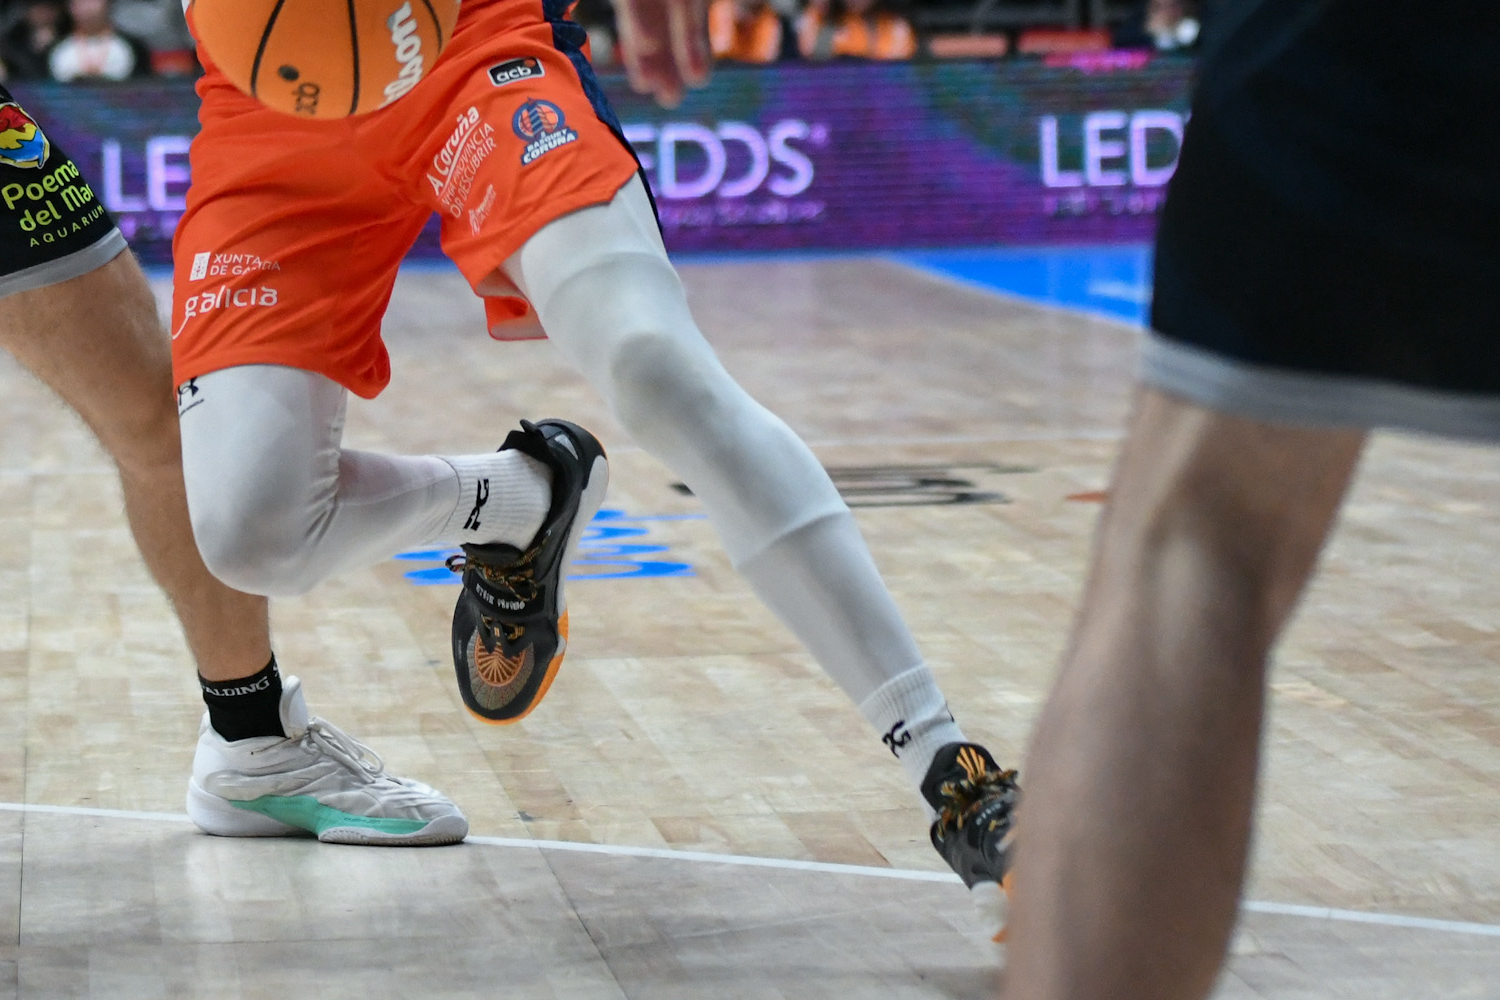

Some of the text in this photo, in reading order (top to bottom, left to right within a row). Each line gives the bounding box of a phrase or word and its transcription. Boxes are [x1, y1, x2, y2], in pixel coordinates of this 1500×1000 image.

[496, 65, 532, 83] acb
[433, 106, 480, 176] Coruña
[1, 159, 80, 210] Poema
[19, 183, 95, 232] del Mar
[30, 204, 105, 248] AQUARIUM
[210, 264, 228, 276] DE
[213, 253, 262, 269] XUNTA
[202, 675, 270, 697] ALDING
